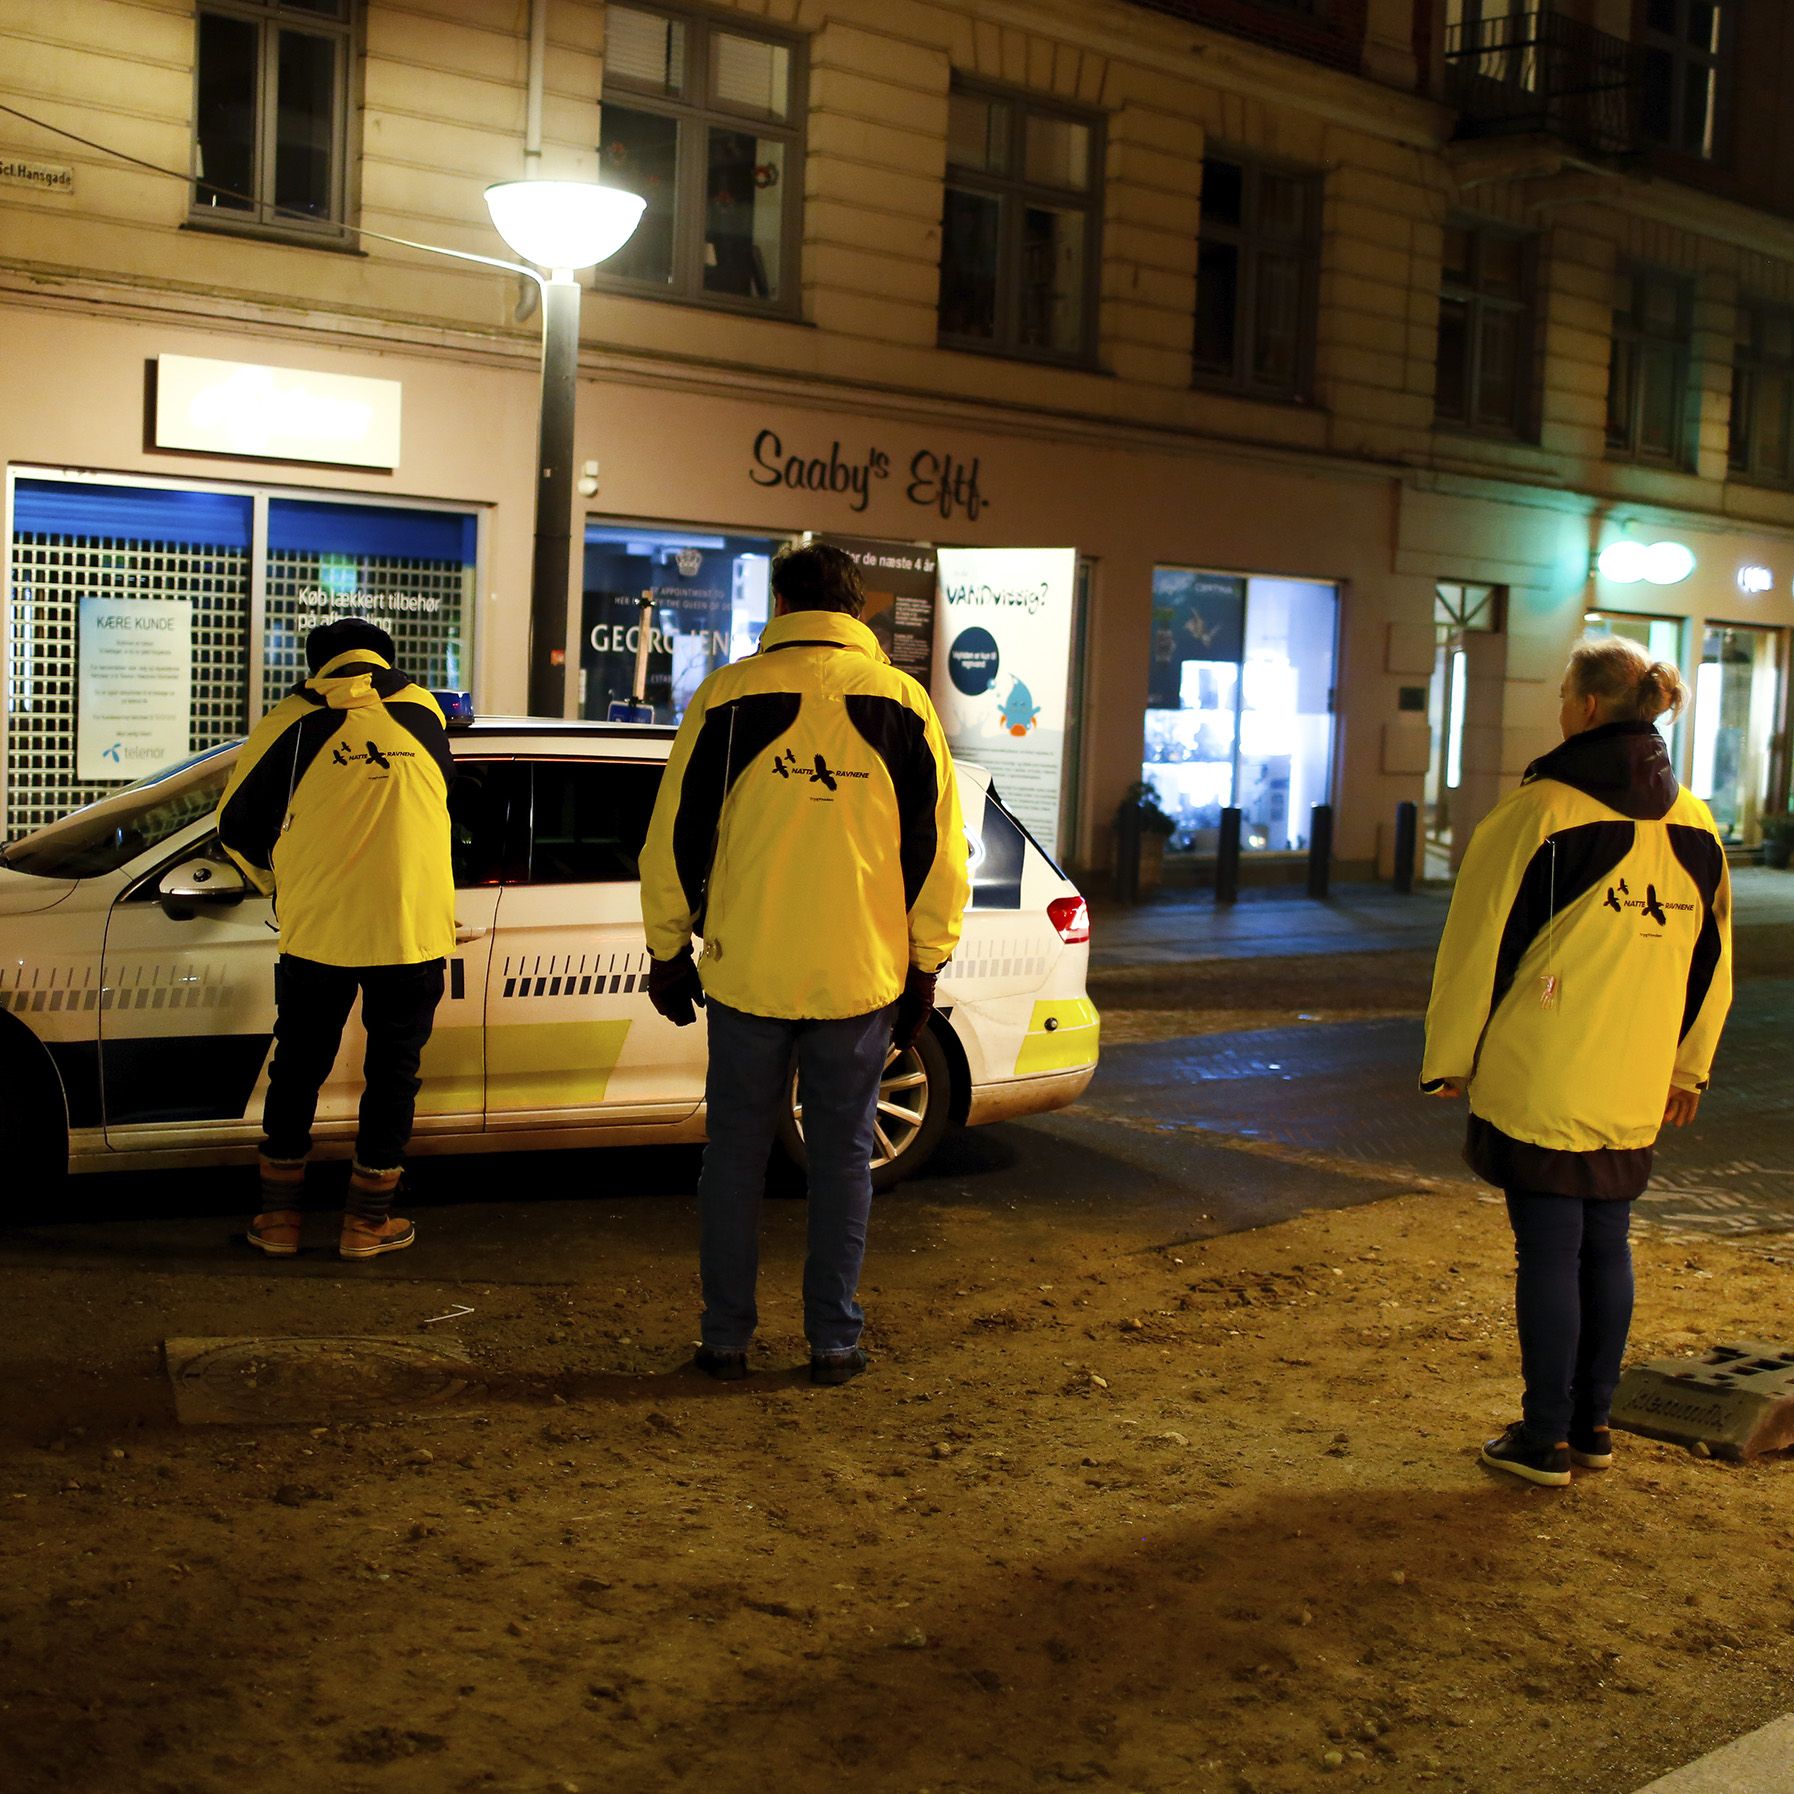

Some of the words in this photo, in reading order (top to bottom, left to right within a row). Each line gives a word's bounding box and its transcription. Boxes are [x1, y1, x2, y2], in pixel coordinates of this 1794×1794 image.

[748, 428, 892, 513] Saaby's
[863, 552, 877, 566] de
[879, 556, 913, 570] næste
[914, 558, 922, 571] 4
[923, 560, 935, 573] år
[298, 586, 328, 607] Køb
[330, 587, 385, 610] lækkert
[387, 591, 441, 613] tilbehør
[96, 616, 131, 630] KÆRE
[135, 617, 175, 632] KUNDE
[298, 609, 317, 632] på
[124, 746, 165, 760] telenor
[791, 768, 814, 776] NATTE
[835, 770, 870, 779] RAVNENE
[1623, 900, 1646, 908] NATTE
